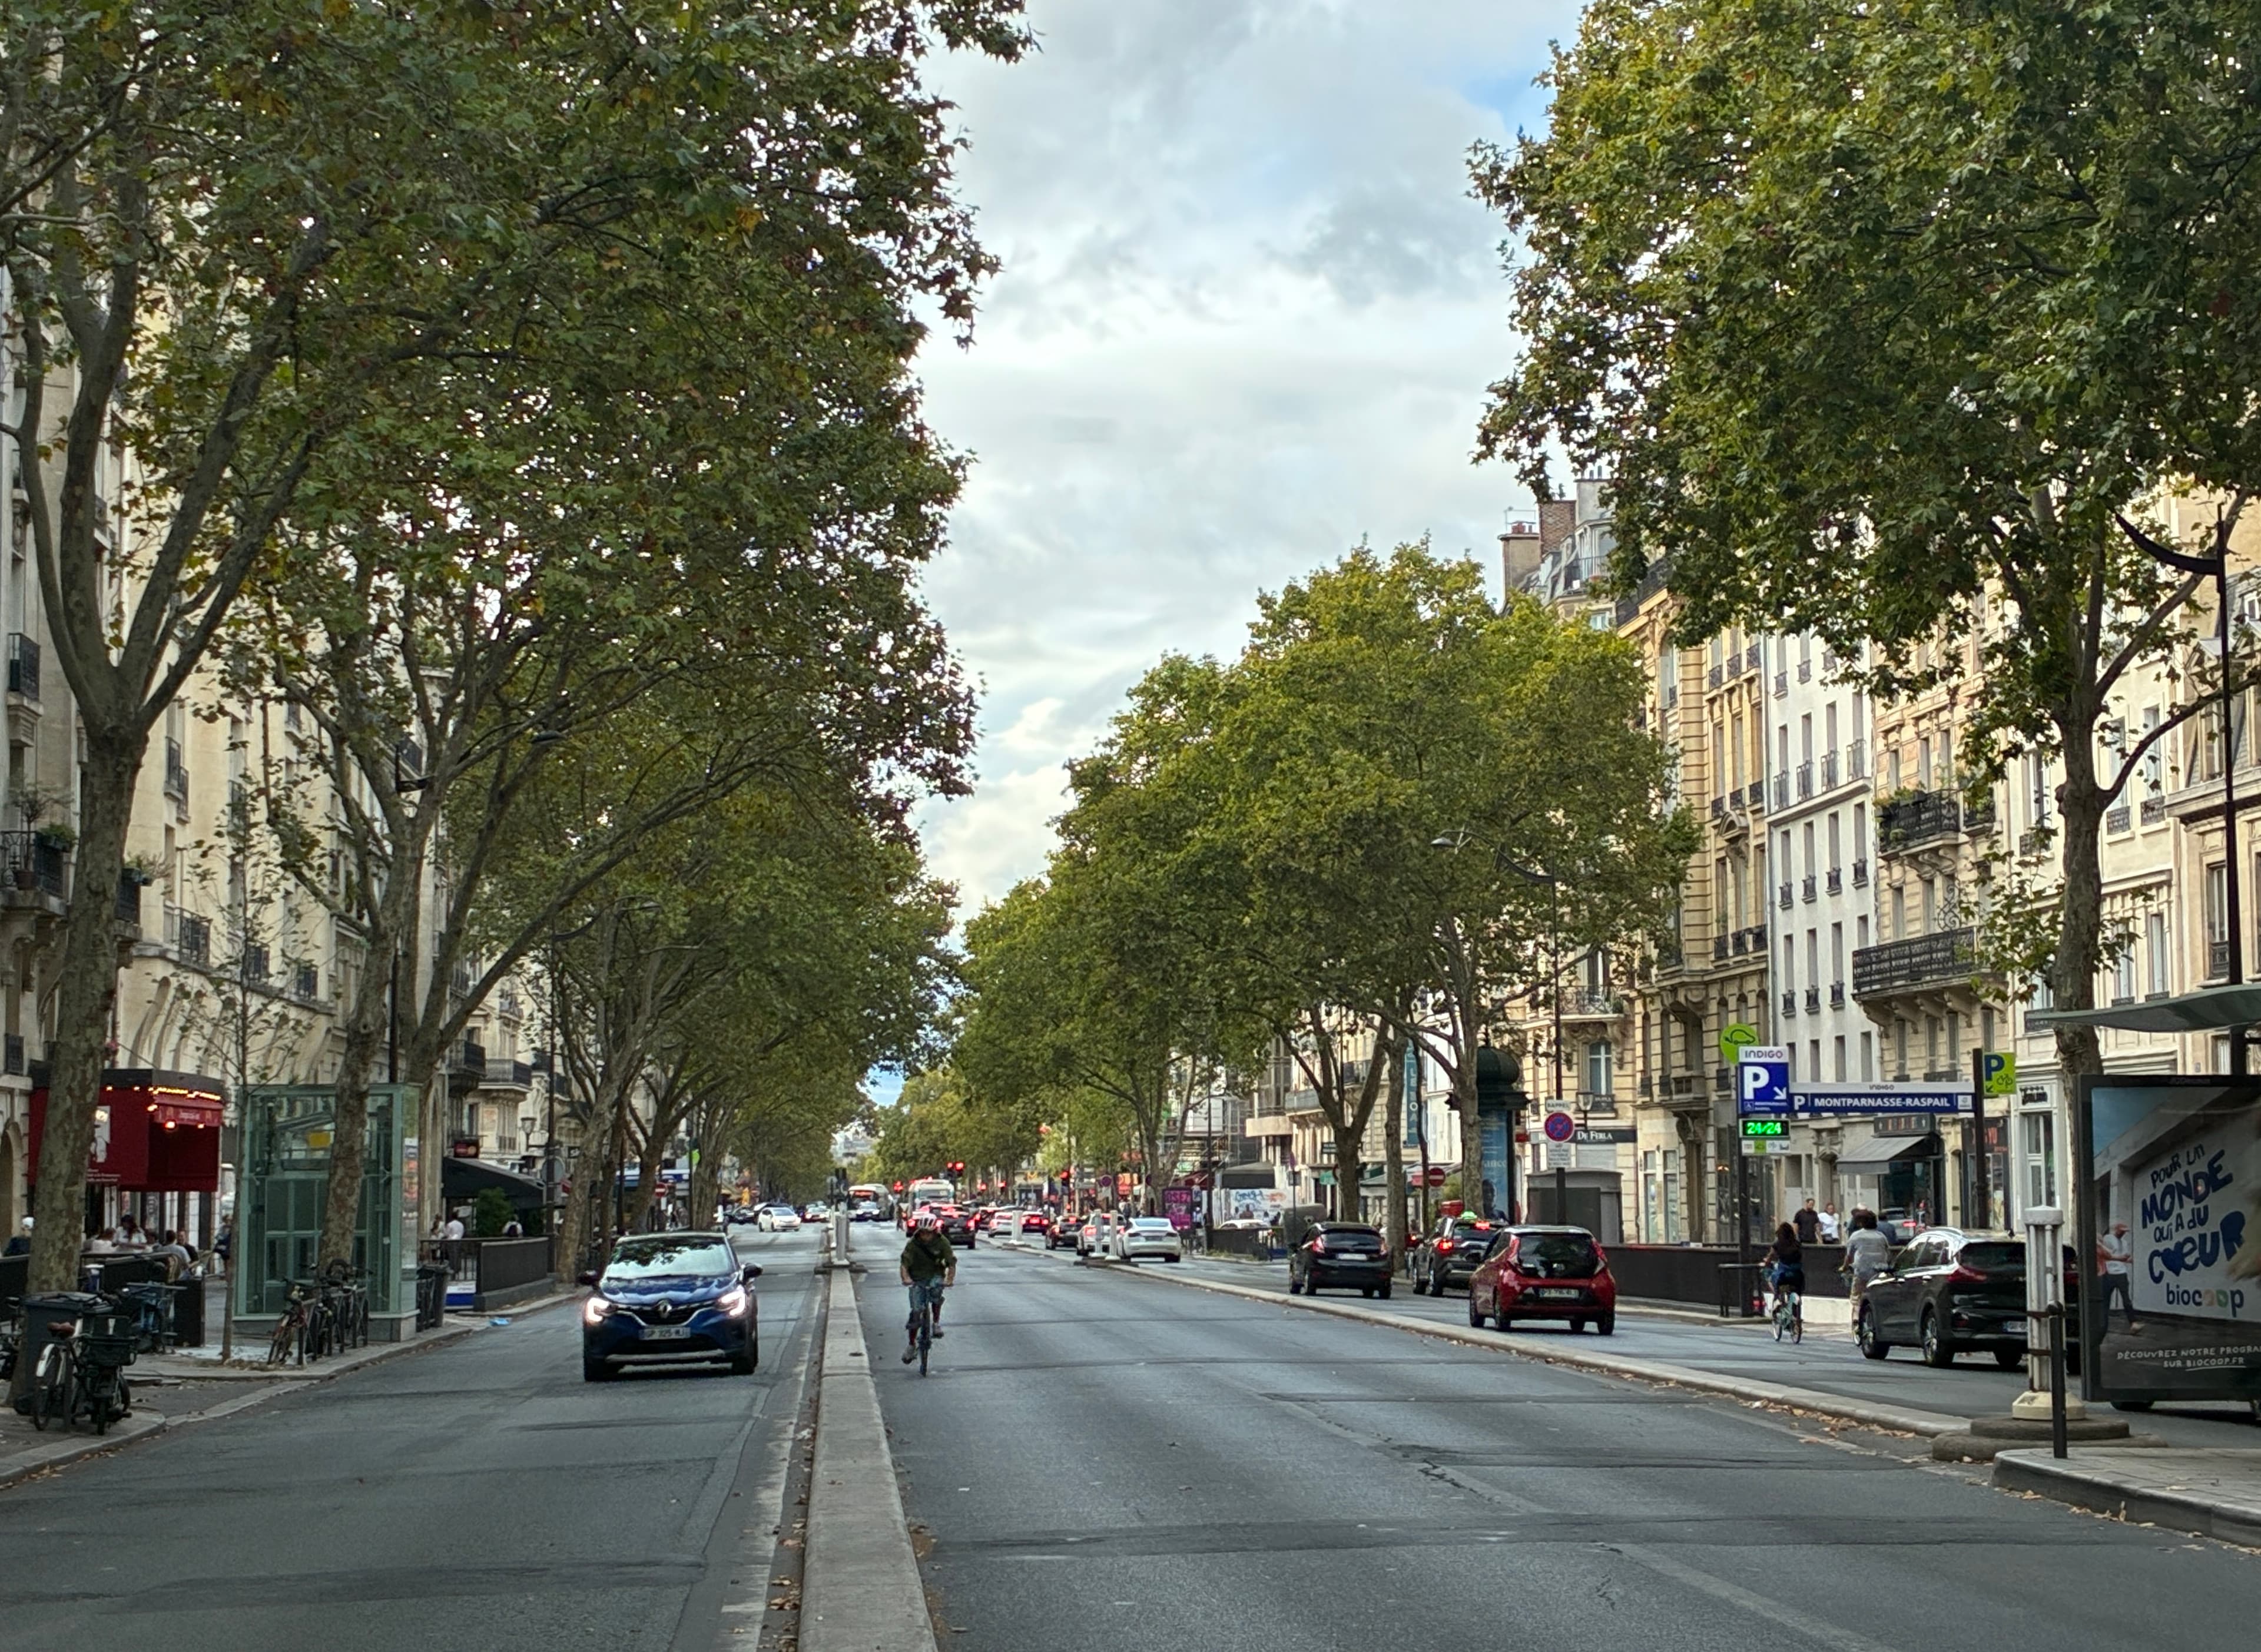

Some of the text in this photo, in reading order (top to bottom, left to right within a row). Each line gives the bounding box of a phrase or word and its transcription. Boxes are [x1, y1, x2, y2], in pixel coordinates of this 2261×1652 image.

[1745, 1050, 1783, 1059] INDIGO
[1984, 1054, 2005, 1082] P
[1743, 1066, 1769, 1100] P
[1794, 1095, 1805, 1110] P
[1814, 1097, 1950, 1107] MONTPARNASSE-RASPAIL
[1747, 1122, 1782, 1134] 24/24
[2150, 1153, 2182, 1189] POUR
[2141, 1149, 2233, 1229] MONDE
[2175, 1212, 2184, 1232] A
[2166, 1282, 2245, 1318] biocoop
[2117, 1345, 2261, 1360] DÉCOUVREZ NOTRE PROGRA
[2186, 1357, 2245, 1367] BIOCOOP.FR
